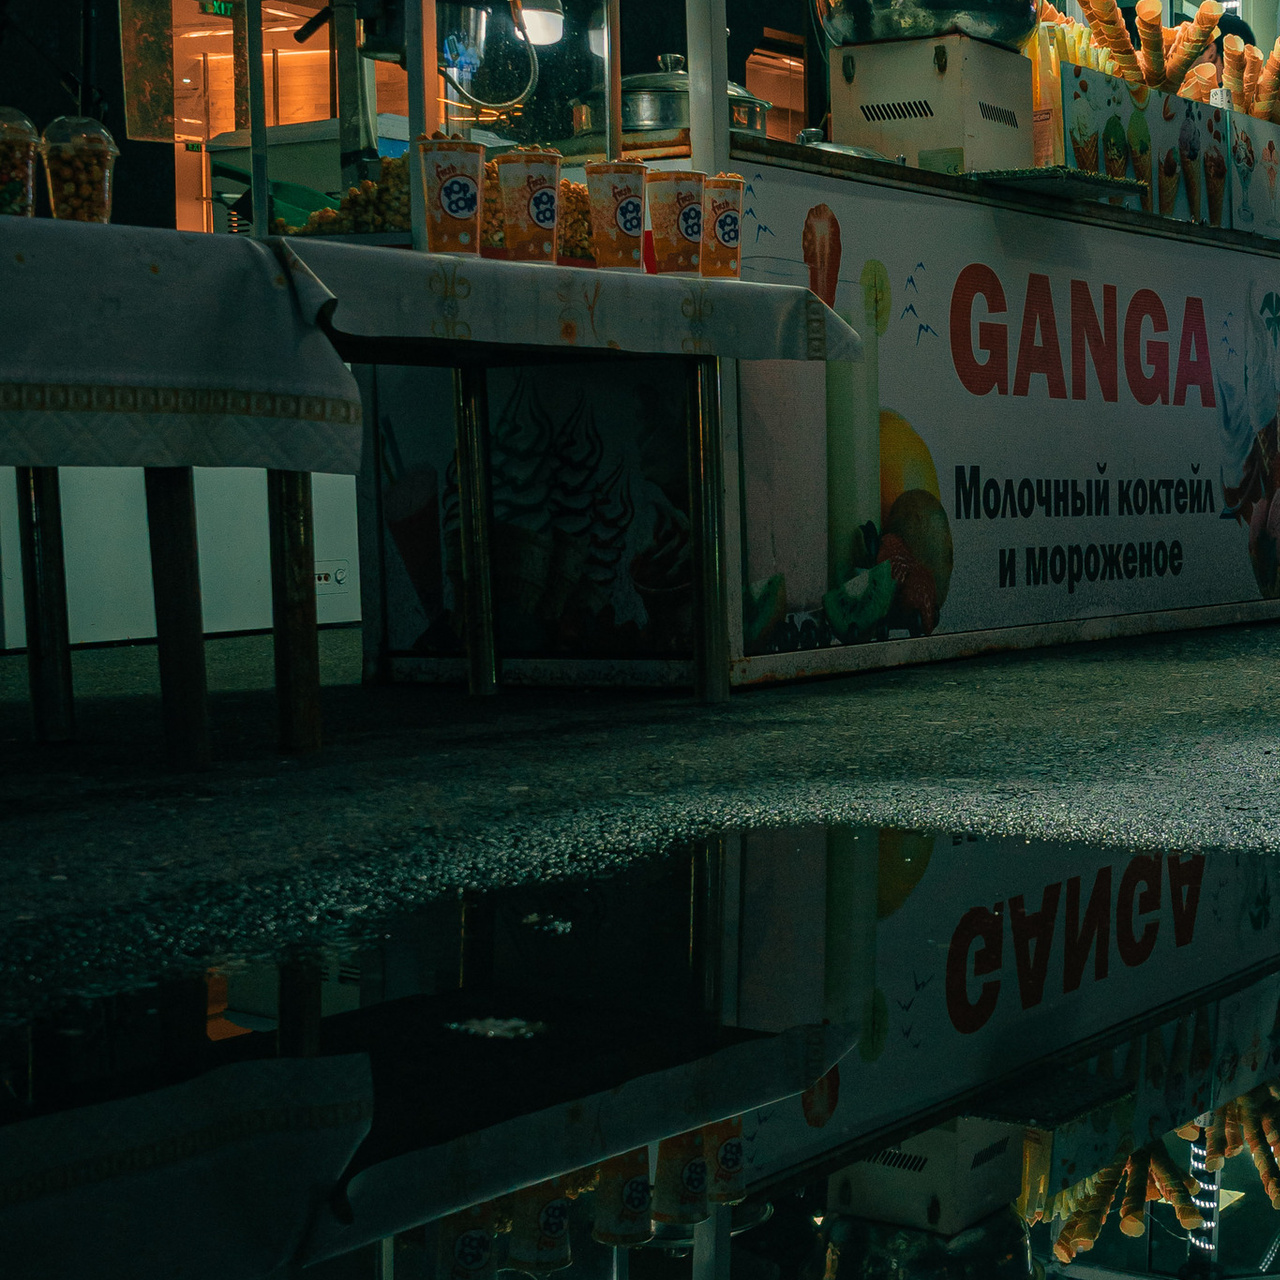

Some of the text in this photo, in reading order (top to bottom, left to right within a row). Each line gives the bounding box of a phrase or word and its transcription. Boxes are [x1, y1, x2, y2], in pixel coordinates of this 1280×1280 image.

[949, 262, 1217, 409] GANGA
[954, 462, 1216, 521] Молочный коктейл
[999, 537, 1184, 594] и мороженое
